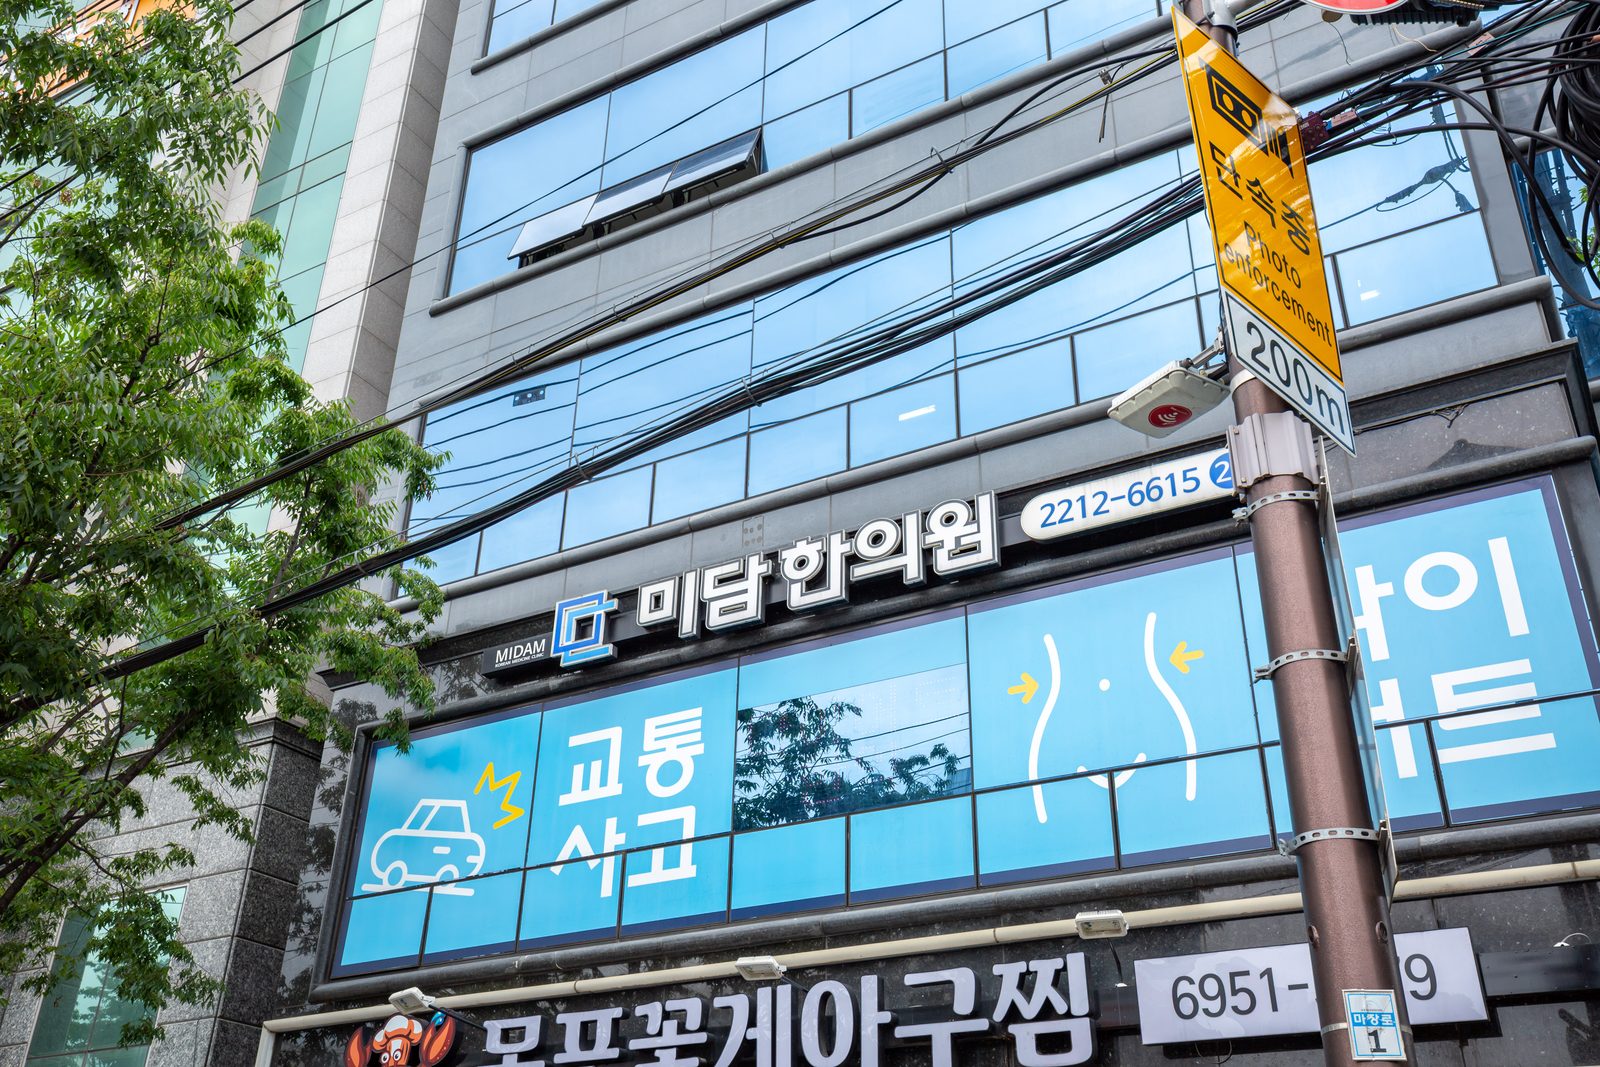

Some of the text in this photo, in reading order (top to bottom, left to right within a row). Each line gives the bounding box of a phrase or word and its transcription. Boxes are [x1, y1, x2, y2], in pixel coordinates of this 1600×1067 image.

[1208, 140, 1311, 256] 단속중
[1224, 241, 1333, 348] enforcement
[1243, 220, 1302, 289] Photo
[1246, 320, 1346, 436] 200m
[1040, 467, 1201, 528] 2212-6615
[636, 489, 1001, 640] 미담한의원
[494, 660, 511, 668] KOREAN
[512, 655, 531, 664] MEDICINE
[495, 638, 546, 663] MIDAM
[558, 706, 705, 807] 교통
[549, 805, 697, 898] 사고
[1368, 1029, 1387, 1053] 1
